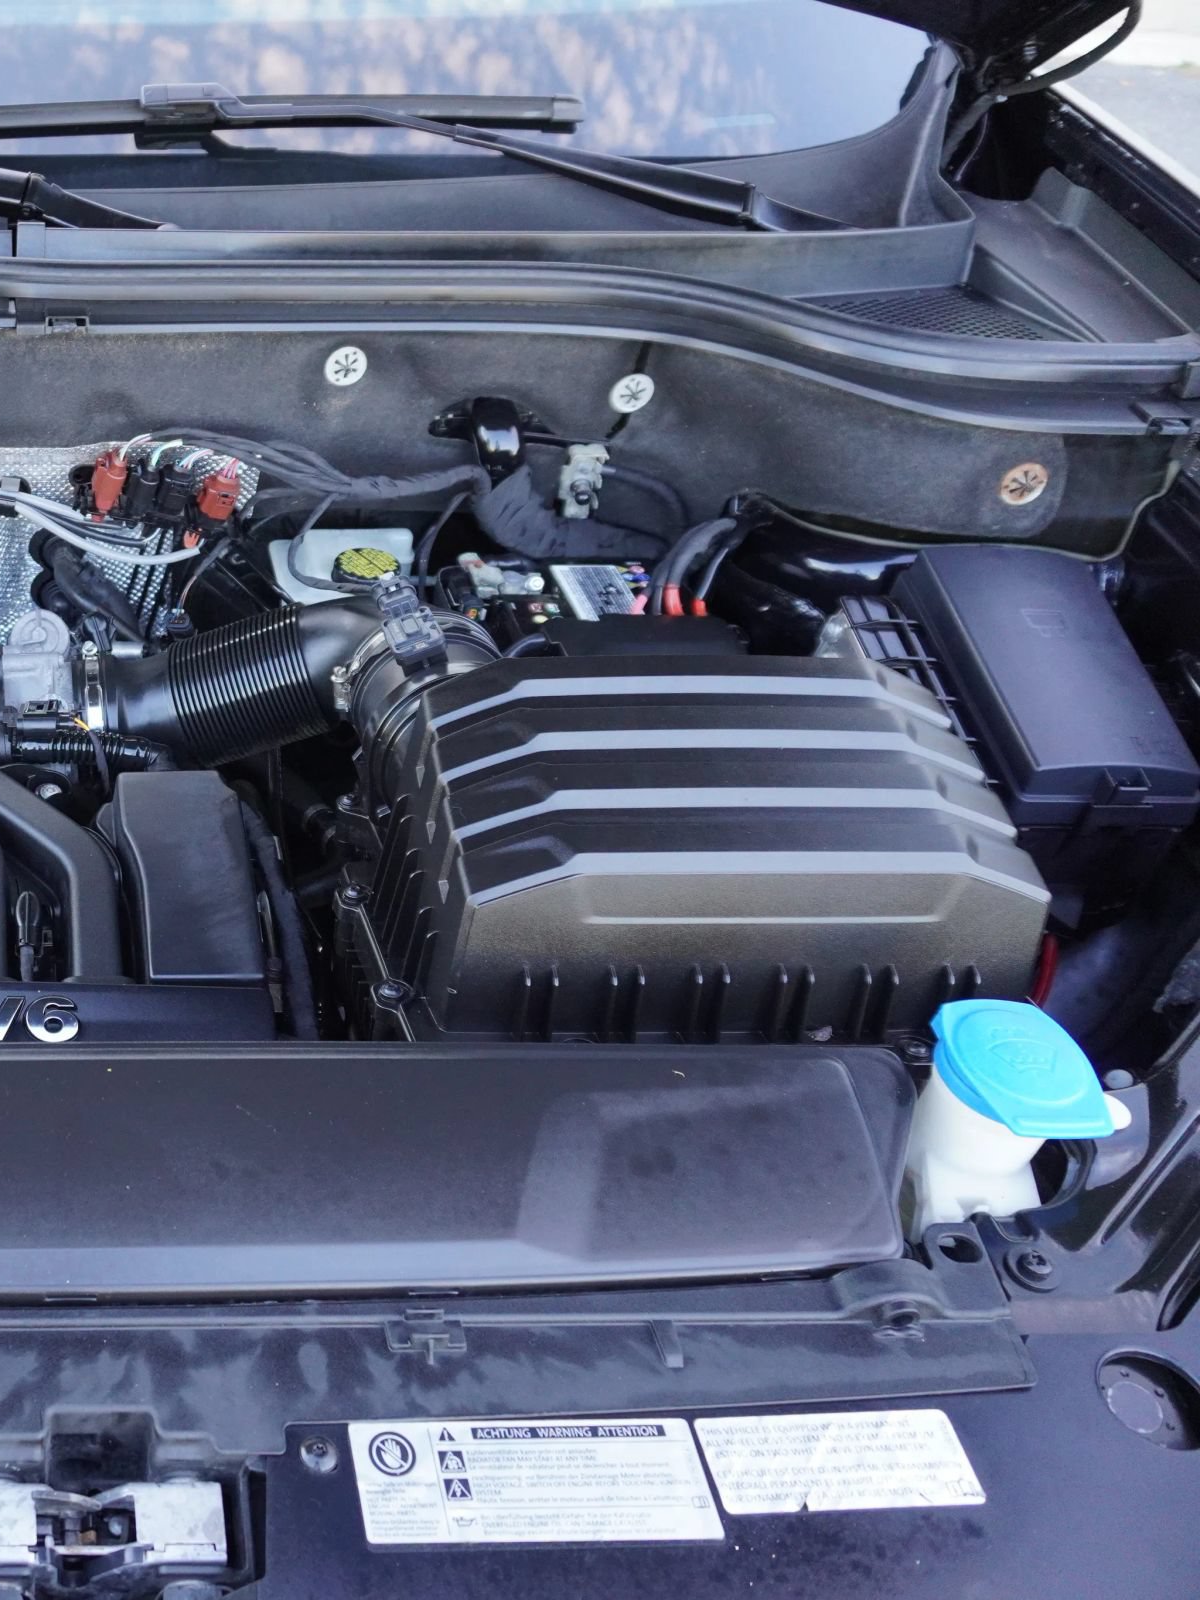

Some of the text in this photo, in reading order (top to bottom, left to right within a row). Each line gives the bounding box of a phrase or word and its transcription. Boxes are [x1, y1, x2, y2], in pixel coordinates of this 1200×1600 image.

[476, 1425, 658, 1440] ACHTUNG WARNING ATTENTION
[700, 1426, 723, 1436] THIS
[723, 1425, 760, 1435] VEHICLE
[762, 1424, 771, 1434] IS
[773, 1423, 818, 1434] EQUIPPED
[820, 1421, 845, 1432] WH
[855, 1418, 910, 1430] PERMANT
[785, 1434, 820, 1445] SYSTEM
